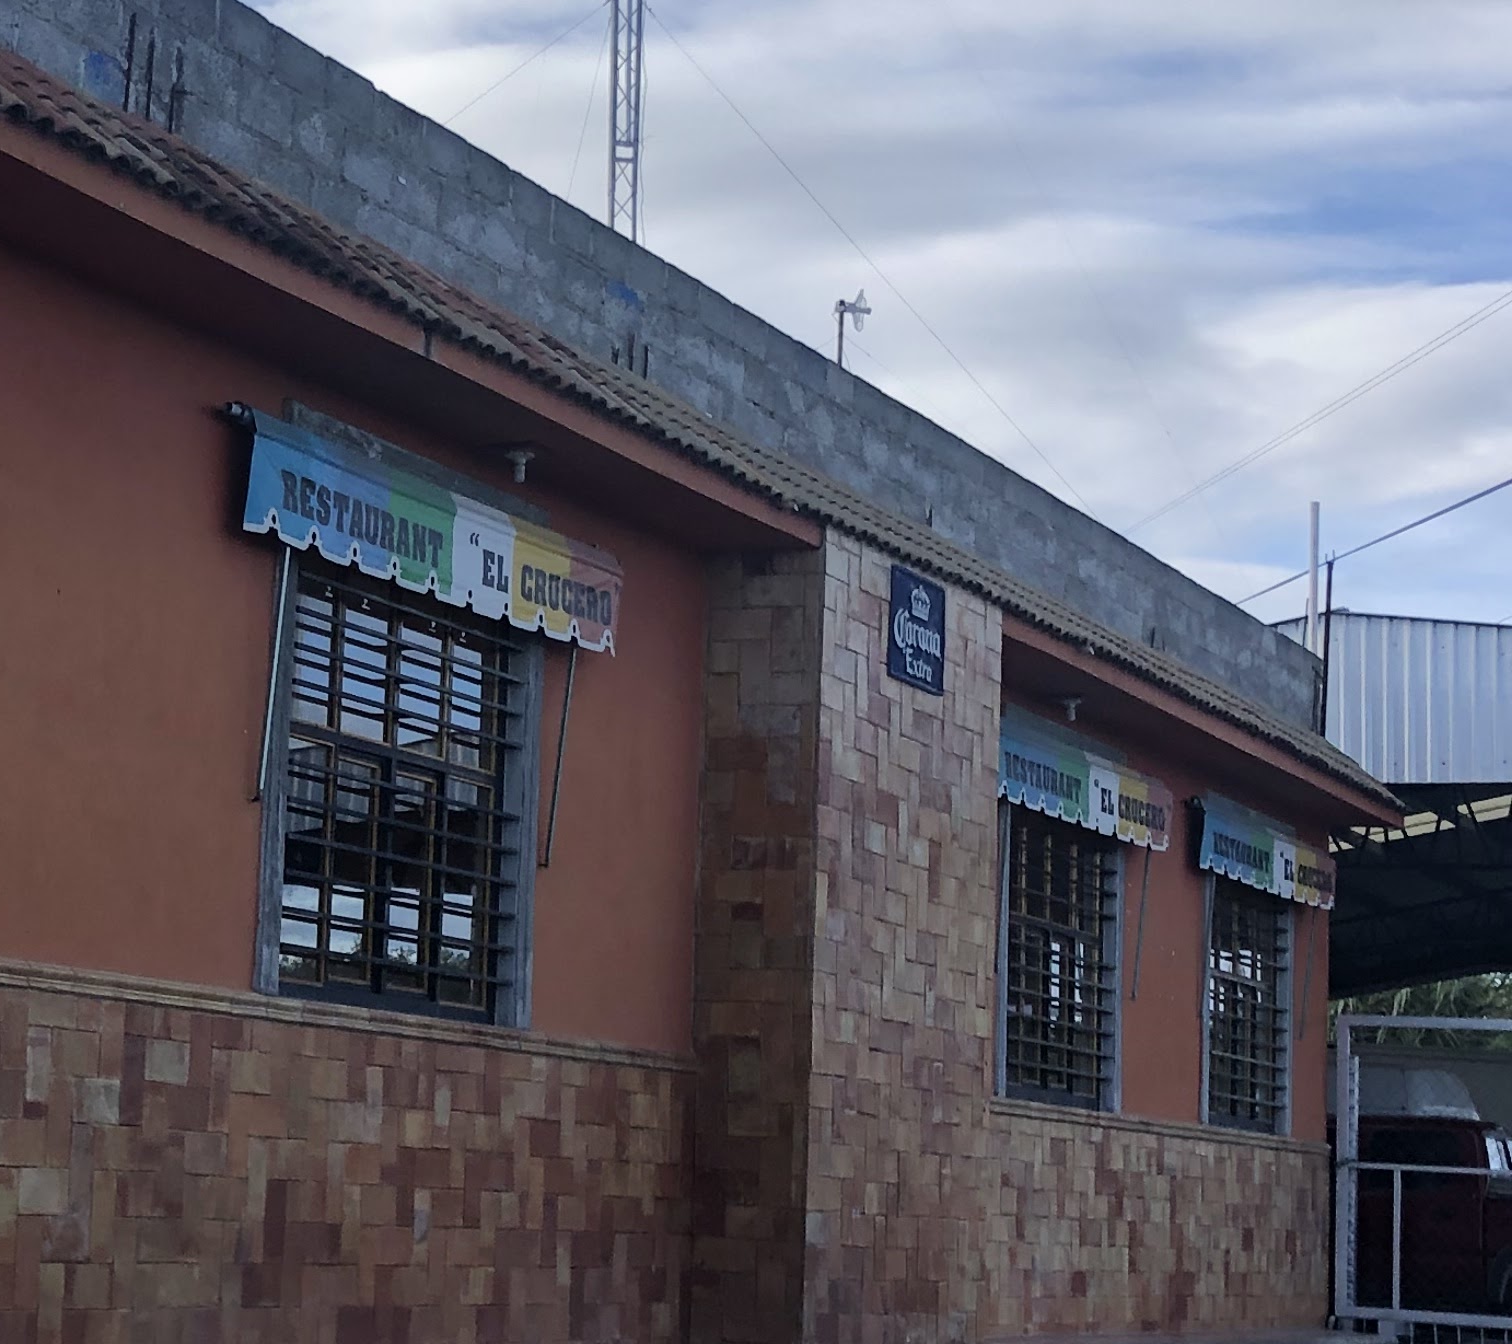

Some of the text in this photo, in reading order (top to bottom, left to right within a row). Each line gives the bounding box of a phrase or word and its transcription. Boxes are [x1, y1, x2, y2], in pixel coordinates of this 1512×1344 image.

[281, 469, 443, 569] RESTAURANT
[893, 608, 942, 662] Corona
[903, 648, 933, 683] Extra
